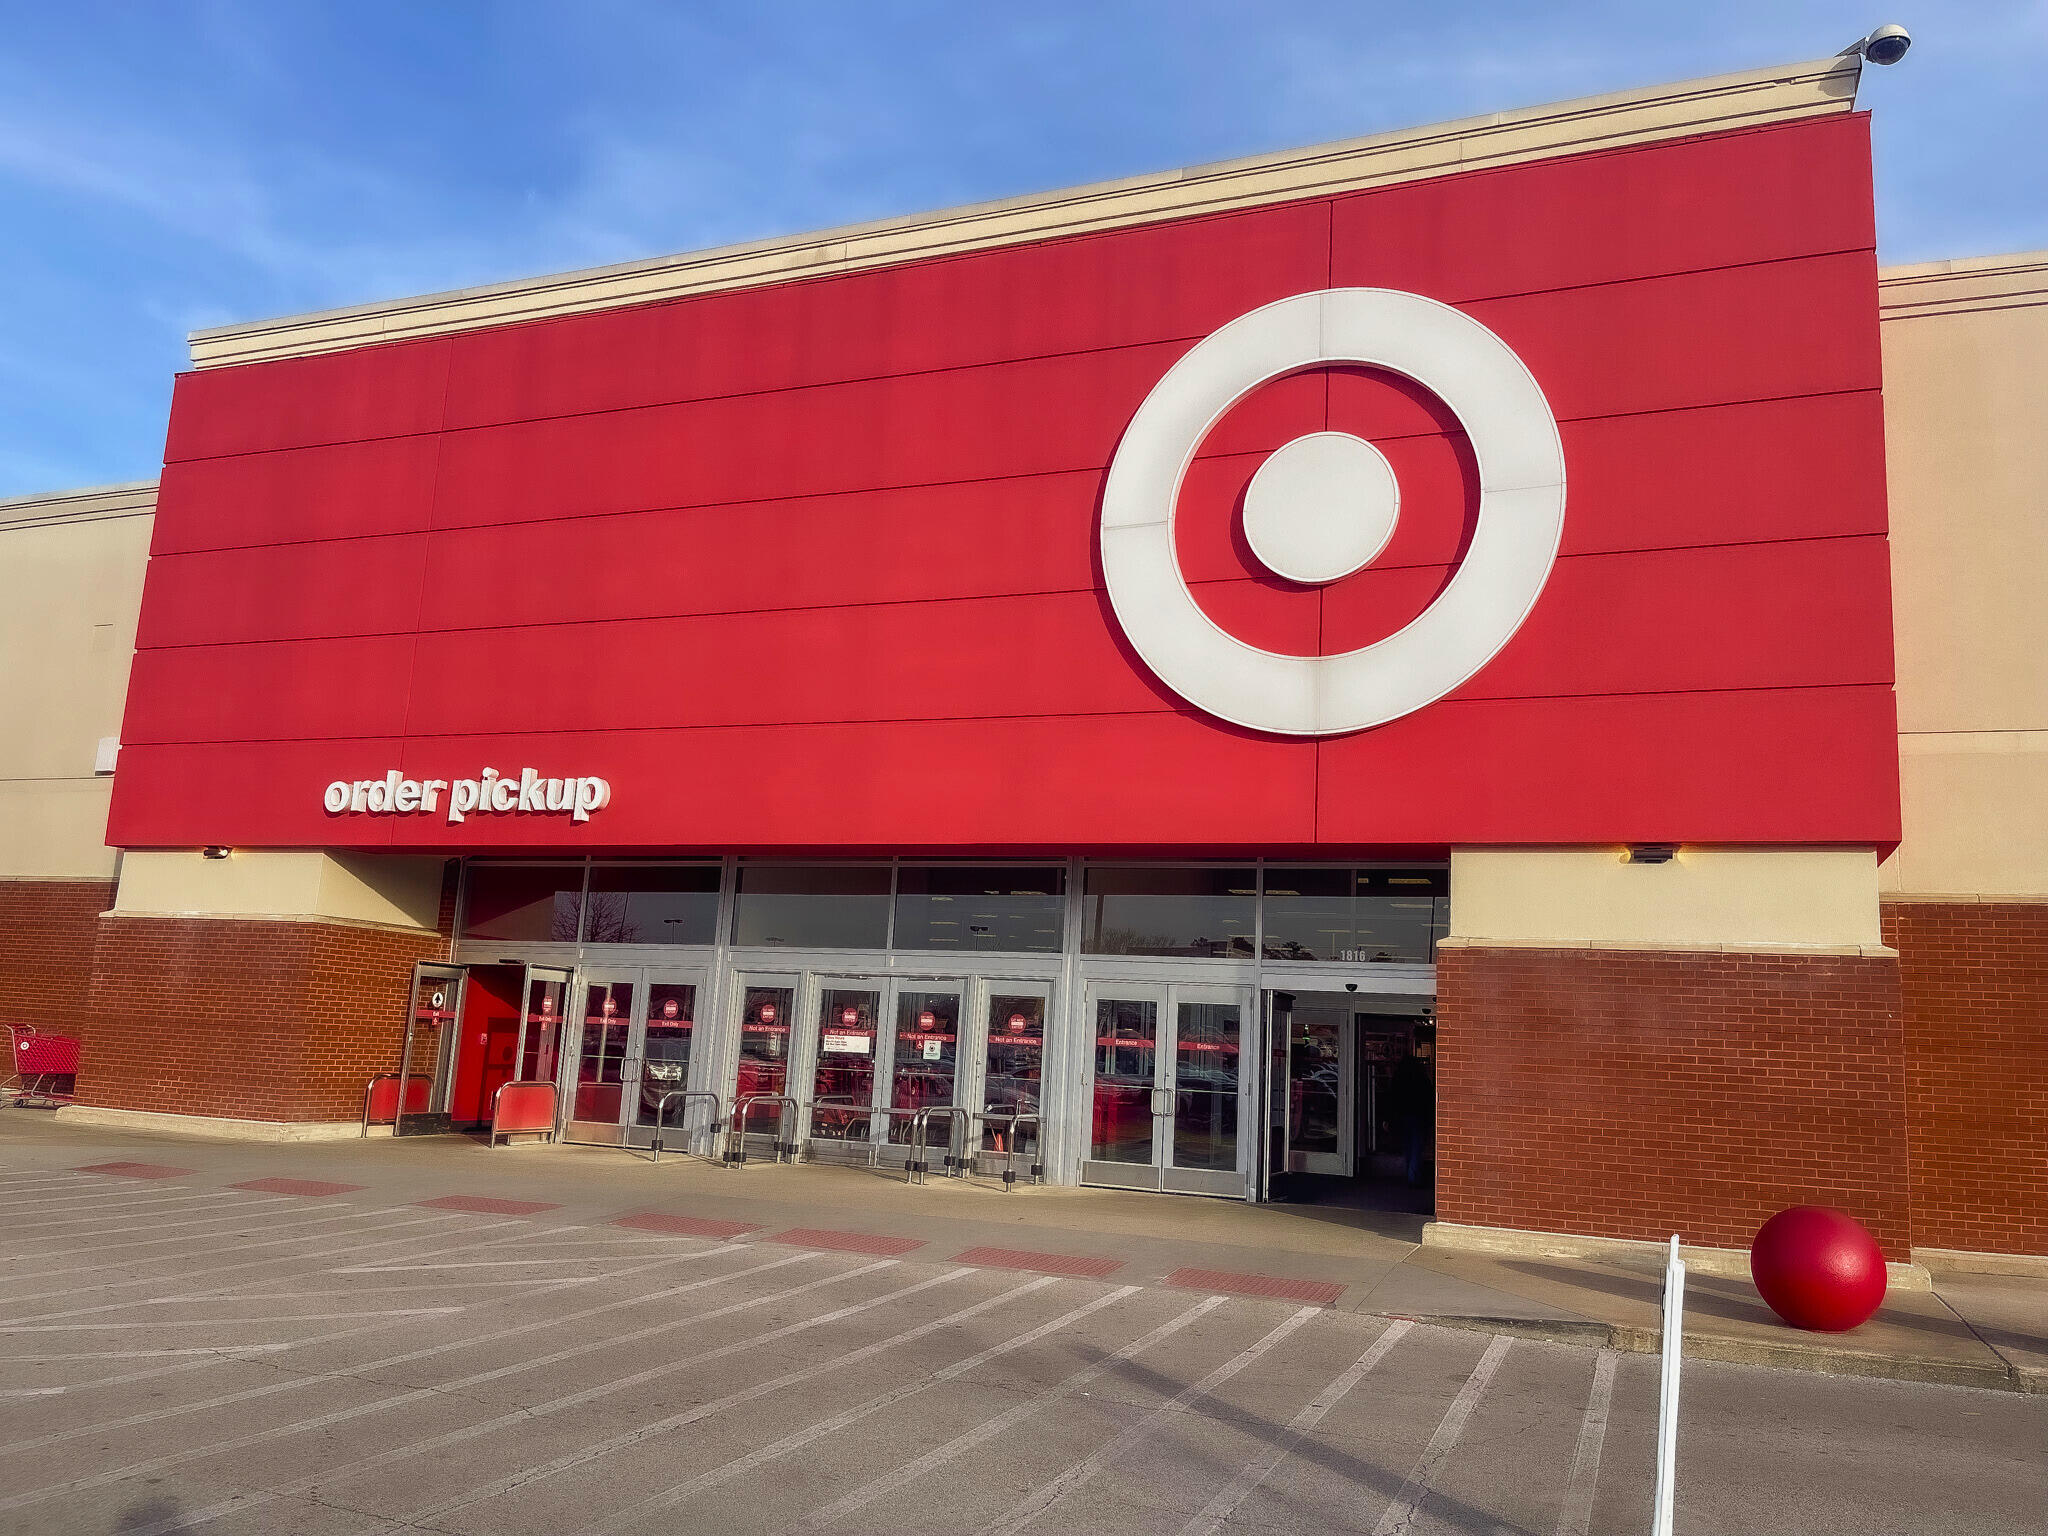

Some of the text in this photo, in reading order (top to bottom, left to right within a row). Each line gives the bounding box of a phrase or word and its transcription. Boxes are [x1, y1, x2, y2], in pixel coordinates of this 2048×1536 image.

[324, 767, 611, 822] order pickup
[1340, 949, 1366, 962] 1816
[846, 1029, 868, 1037] Entrance
[1013, 1037, 1037, 1045] Entrance
[1115, 1038, 1138, 1046] Entrance
